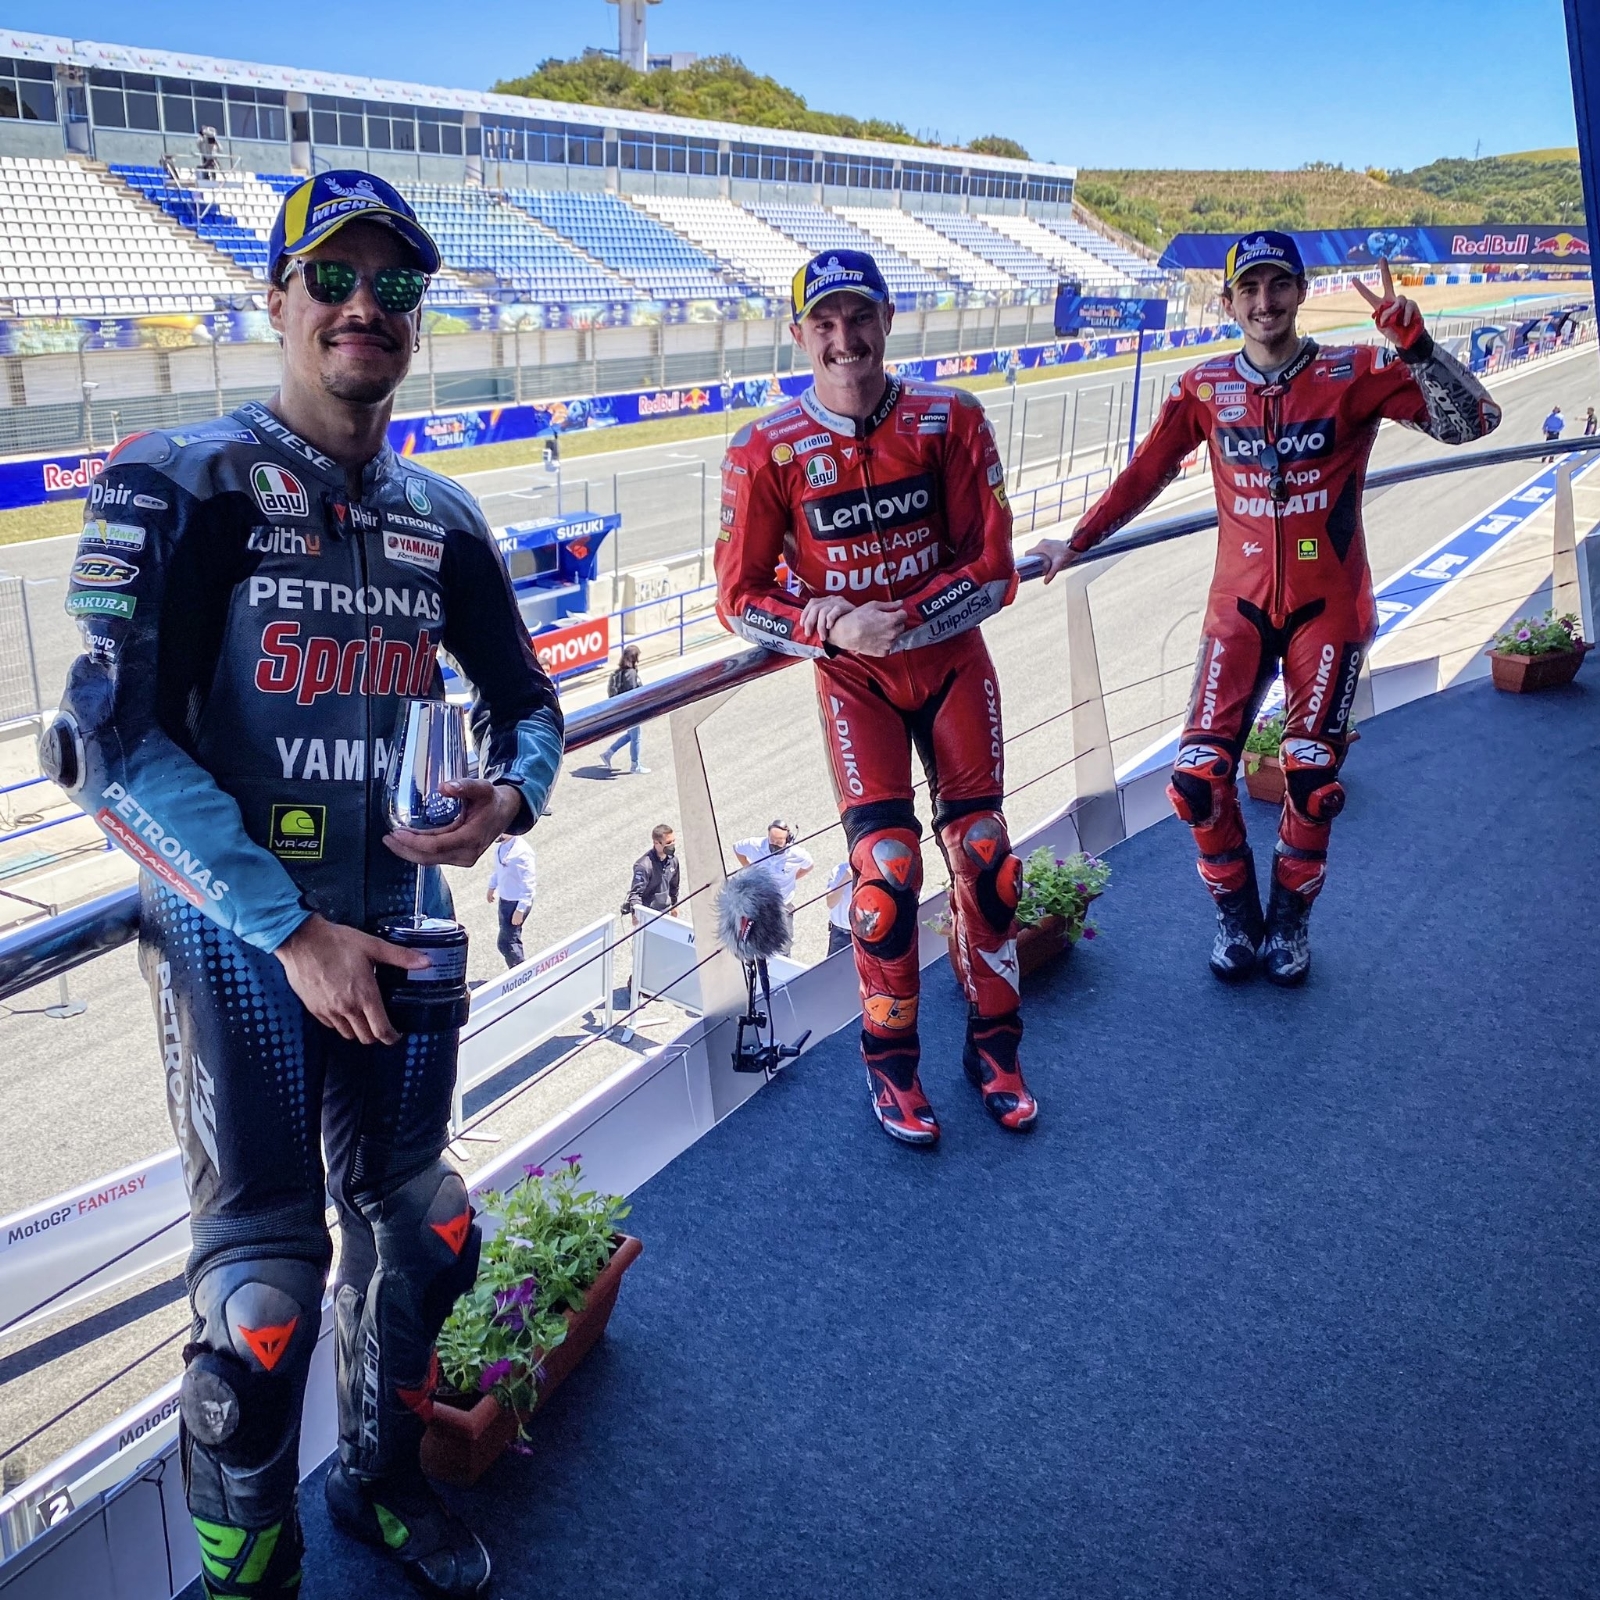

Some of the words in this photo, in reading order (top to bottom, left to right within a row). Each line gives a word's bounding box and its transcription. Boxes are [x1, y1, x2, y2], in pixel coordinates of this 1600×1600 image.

[1235, 249, 1285, 268] MICHELIN
[1452, 235, 1491, 255] Red
[1490, 234, 1529, 255] Bull
[806, 273, 864, 298] MICHELIN
[1283, 354, 1310, 380] Lenovo
[1330, 365, 1351, 373] Lenovo
[638, 394, 660, 415] Red
[659, 391, 680, 413] Bull
[872, 376, 901, 427] Lenovo
[1224, 383, 1245, 391] riello
[241, 403, 336, 471] DAINESE
[779, 420, 809, 434] motorola
[803, 434, 830, 448] riello
[44, 459, 89, 492] Red
[813, 490, 929, 532] Lenovo
[1233, 489, 1328, 518] DUCATI
[387, 513, 446, 536] PETRONAS
[556, 519, 603, 540] SUZUKI
[400, 538, 440, 559] YAMAHA
[851, 526, 930, 559] NetApp
[825, 542, 939, 592] DUCATI
[250, 576, 441, 621] PETRONAS
[922, 581, 972, 615] Lenovo
[745, 608, 788, 634] Lenovo
[1201, 660, 1222, 730] DAIKO
[1308, 643, 1335, 716] DAIKO
[1328, 650, 1360, 734] Lenovo
[983, 678, 1002, 761] DAIKO
[836, 719, 864, 796] DAIKO
[101, 781, 230, 901] PETRONAS
[101, 815, 200, 904] BARRACUDA
[535, 948, 570, 976] FANTASY
[77, 1175, 146, 1215] FANTASY
[49, 1495, 70, 1527] 2
